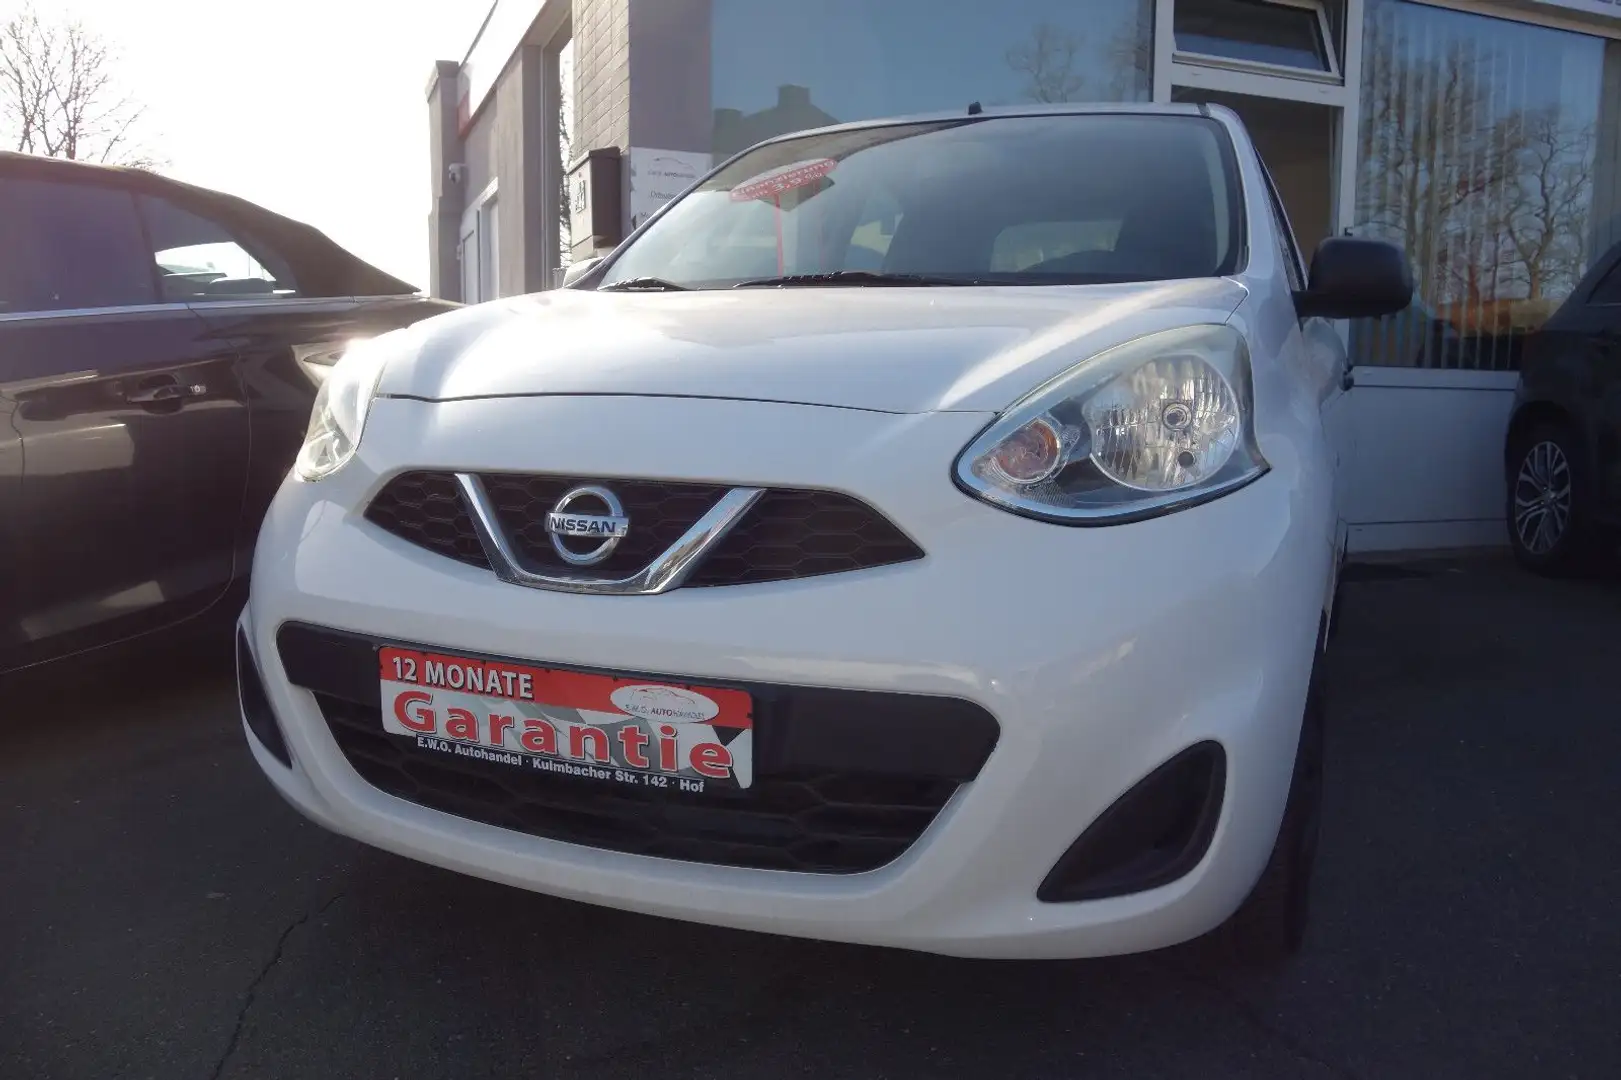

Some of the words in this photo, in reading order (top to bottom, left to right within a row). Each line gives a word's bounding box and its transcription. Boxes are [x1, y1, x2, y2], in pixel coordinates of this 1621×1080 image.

[550, 516, 617, 533] NISSAN
[392, 656, 418, 682] 12
[425, 660, 535, 700] MONATE
[393, 690, 734, 779] Garantie
[416, 738, 452, 753] E.W.O.
[454, 743, 523, 766] Autohandel
[532, 757, 612, 780] Kulmbacher
[615, 770, 639, 784] Str.
[642, 774, 668, 788] 142
[679, 779, 705, 793] Hof
